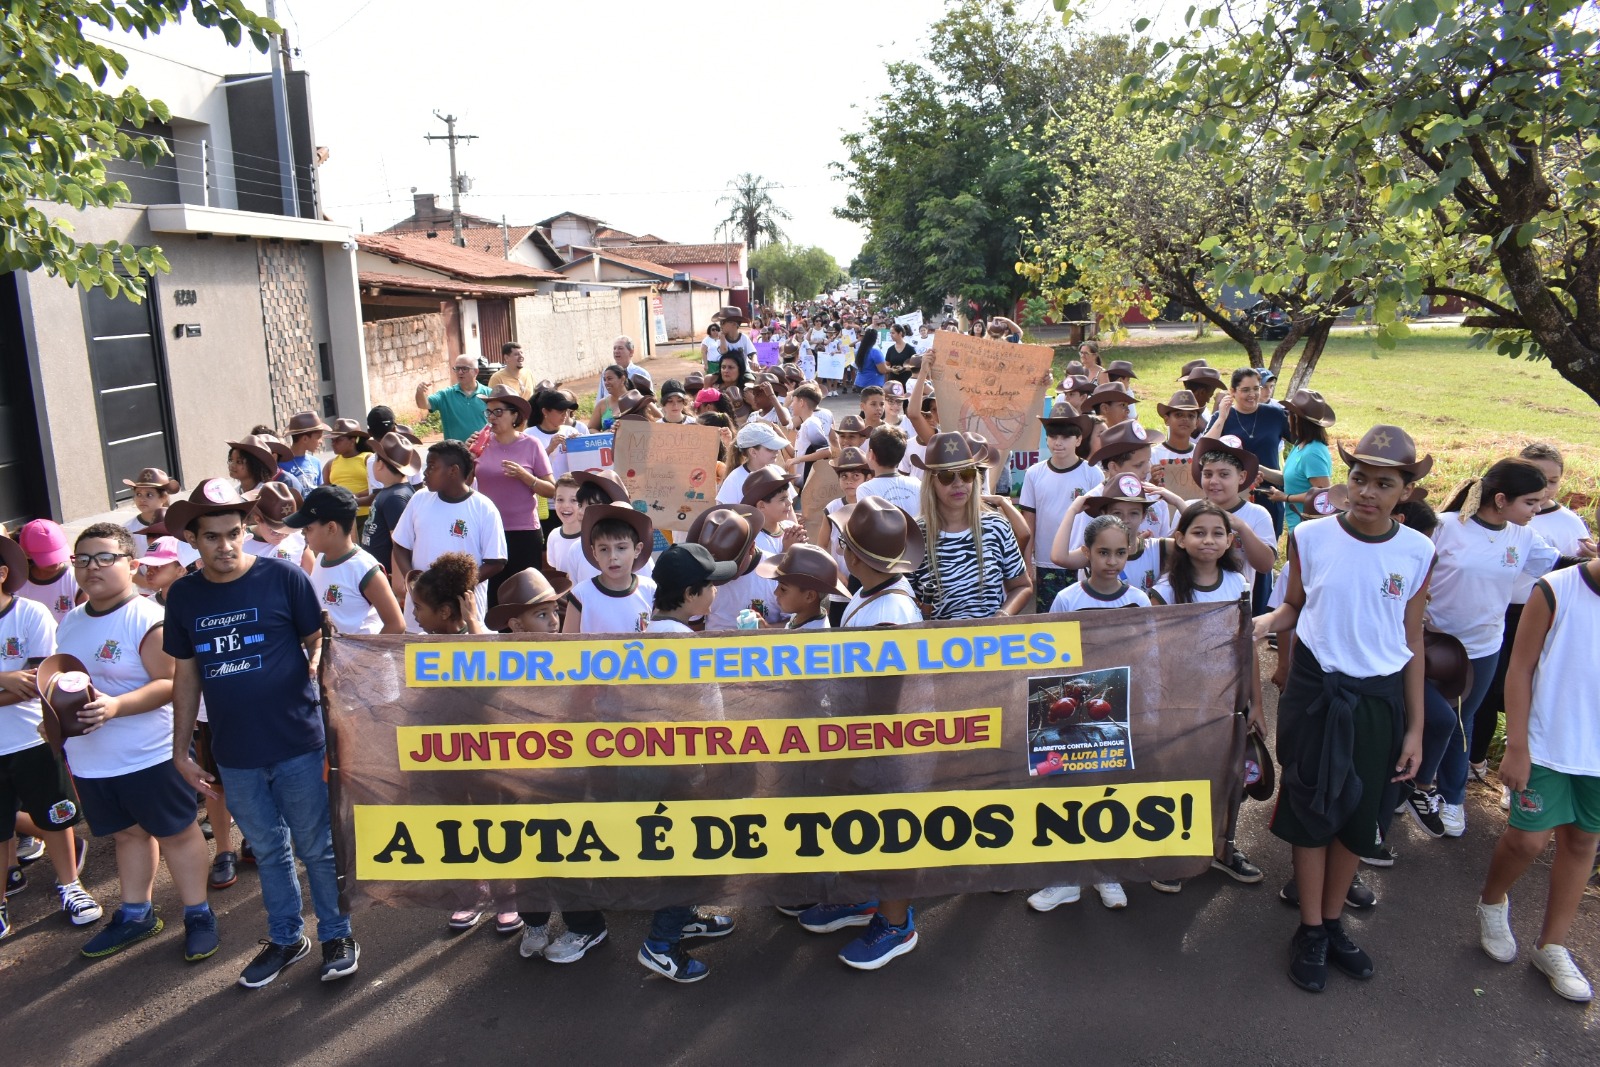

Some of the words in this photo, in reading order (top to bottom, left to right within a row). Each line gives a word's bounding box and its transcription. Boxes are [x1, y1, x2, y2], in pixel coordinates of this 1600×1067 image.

[584, 439, 609, 448] SAIBA
[200, 611, 248, 628] Coragem
[213, 627, 241, 655] FÉ
[689, 640, 907, 679] FERREIRA
[917, 632, 1072, 670] LOPES.
[210, 660, 251, 678] Atitude
[409, 729, 573, 763] JUNTOS
[586, 726, 770, 758] CONTRA
[779, 726, 811, 755] A
[818, 715, 990, 753] DENGUE
[1033, 744, 1067, 752] BARRETOS
[1061, 753, 1069, 761] A
[1070, 751, 1099, 761] LUTA
[1100, 748, 1108, 758] É
[1110, 748, 1125, 758] DE
[1062, 761, 1099, 771] TODOS
[1100, 759, 1127, 769] NÓS!
[373, 821, 425, 865] A
[436, 818, 620, 865] LUTA
[636, 802, 674, 861] É
[690, 813, 768, 860] DE
[784, 804, 1014, 857] TODOS
[1032, 786, 1194, 847] NÓS!
